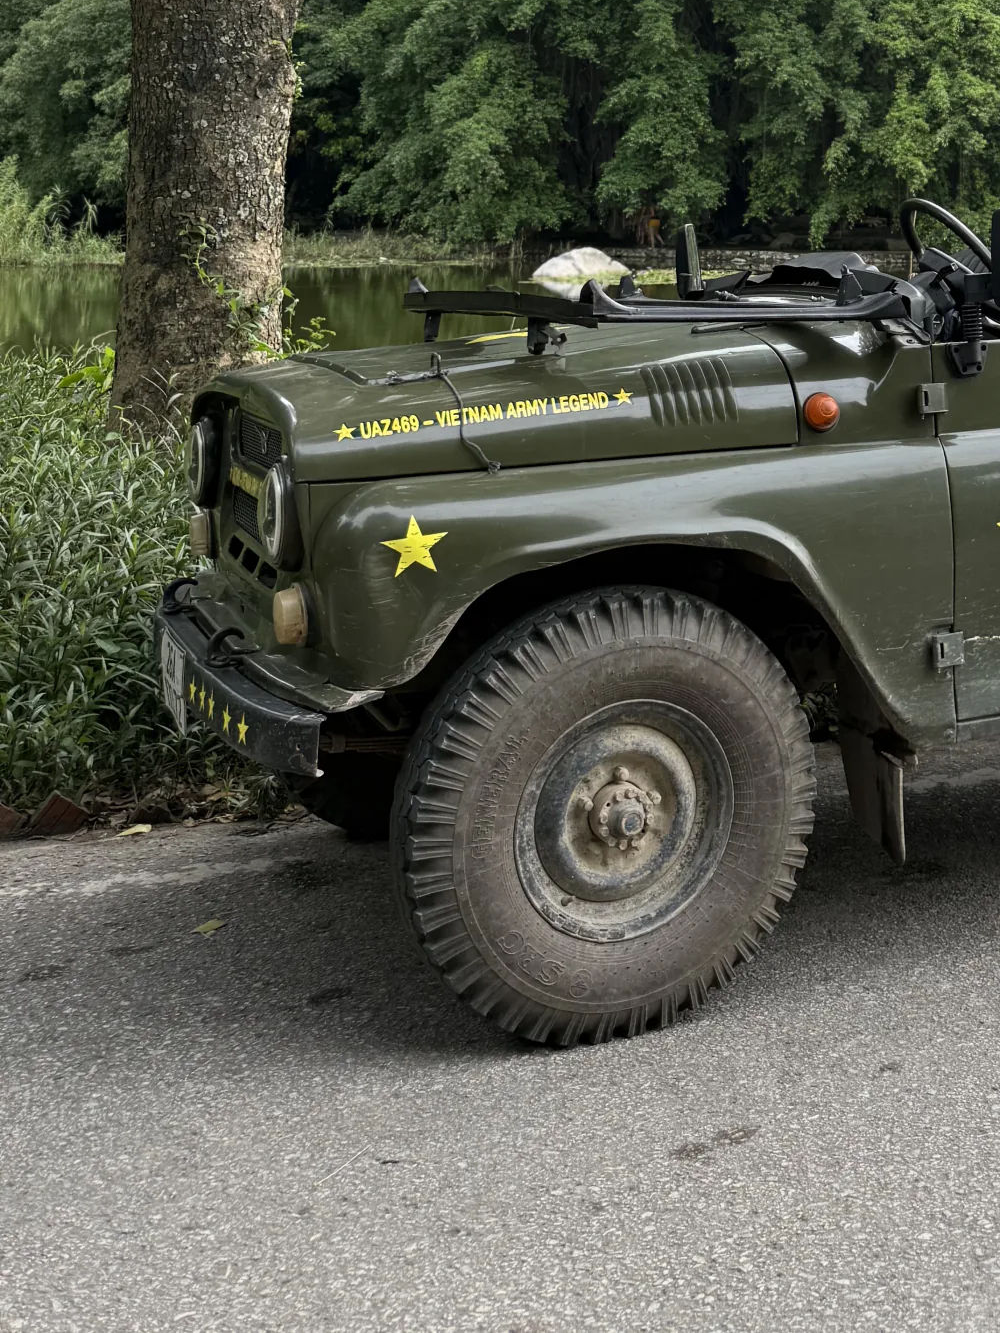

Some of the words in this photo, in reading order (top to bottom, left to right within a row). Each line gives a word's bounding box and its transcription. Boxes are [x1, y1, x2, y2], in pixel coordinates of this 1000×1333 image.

[360, 414, 420, 439] UAZ469
[435, 403, 503, 428] VIETNAM
[506, 397, 548, 419] ARMY
[551, 391, 609, 414] LEGEND
[471, 733, 529, 859] GENERAL
[496, 929, 567, 986] SRC
